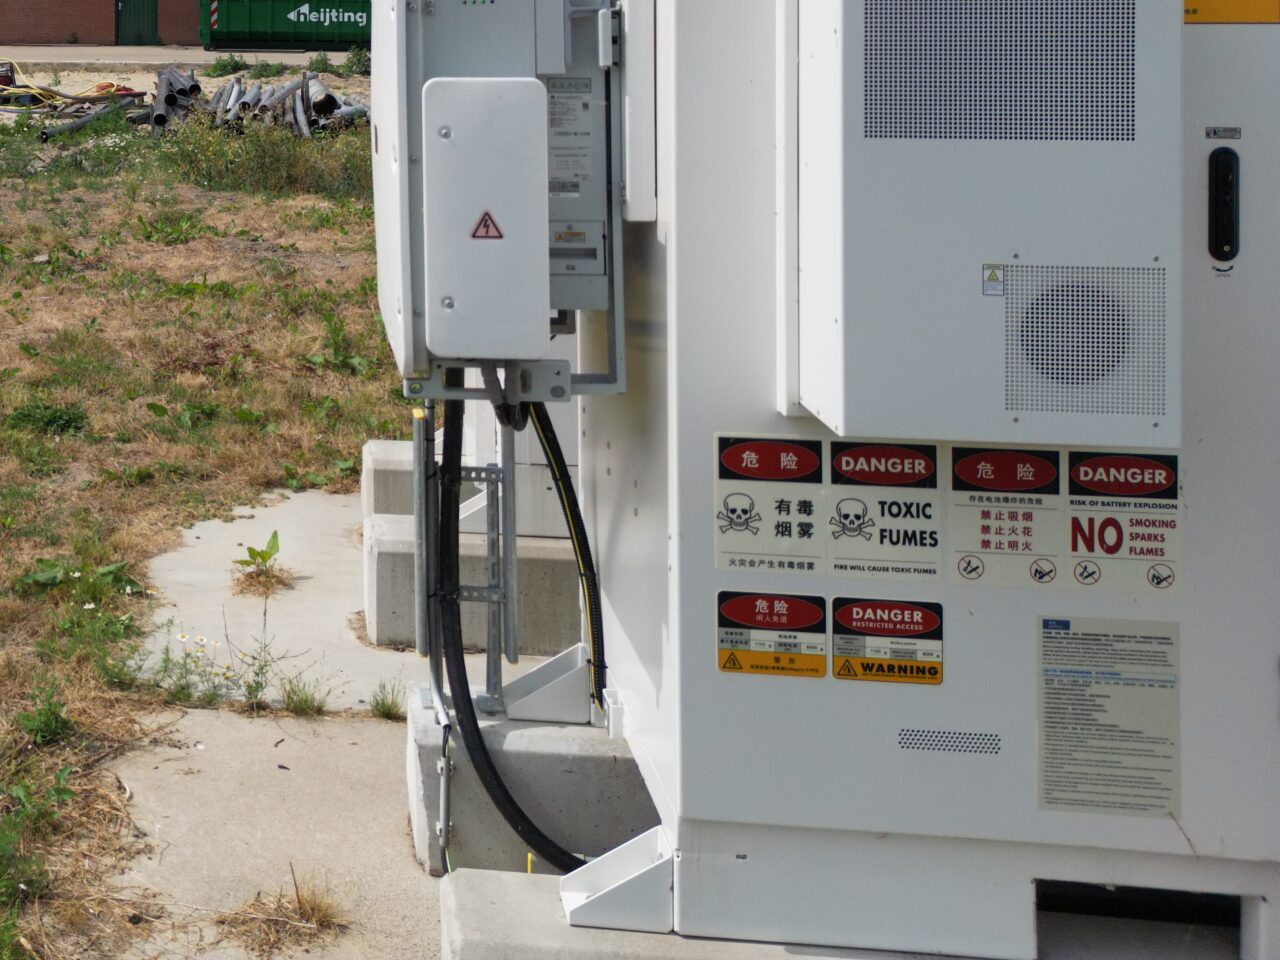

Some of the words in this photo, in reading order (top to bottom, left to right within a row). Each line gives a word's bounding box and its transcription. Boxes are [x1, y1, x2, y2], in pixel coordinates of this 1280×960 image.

[296, 6, 367, 26] heijting
[741, 450, 798, 469] 危险
[841, 456, 926, 474] DANGER
[976, 462, 1035, 481] 危险
[1079, 466, 1167, 484] DANGER
[774, 498, 814, 516] 有毒
[878, 500, 932, 520] TOXIC
[1133, 502, 1178, 510] EXPLOSION
[980, 510, 1033, 522] 禁止吸烟
[1129, 518, 1177, 529] SMOKING
[774, 520, 814, 539] 烟雾
[980, 525, 1033, 537] 禁止火花
[1071, 516, 1124, 555] NO
[1129, 532, 1166, 543] SPARKS
[879, 528, 938, 548] FUMES
[980, 539, 1033, 552] 禁止明火
[1129, 546, 1165, 557] FLAMES
[728, 558, 815, 571] 火灾会产生有毒烟雾
[755, 598, 788, 614] 危险
[852, 607, 923, 623] DANGER
[852, 621, 894, 629] RESTRICTED
[895, 623, 923, 631] ACCESS
[860, 662, 938, 676] WARNING
